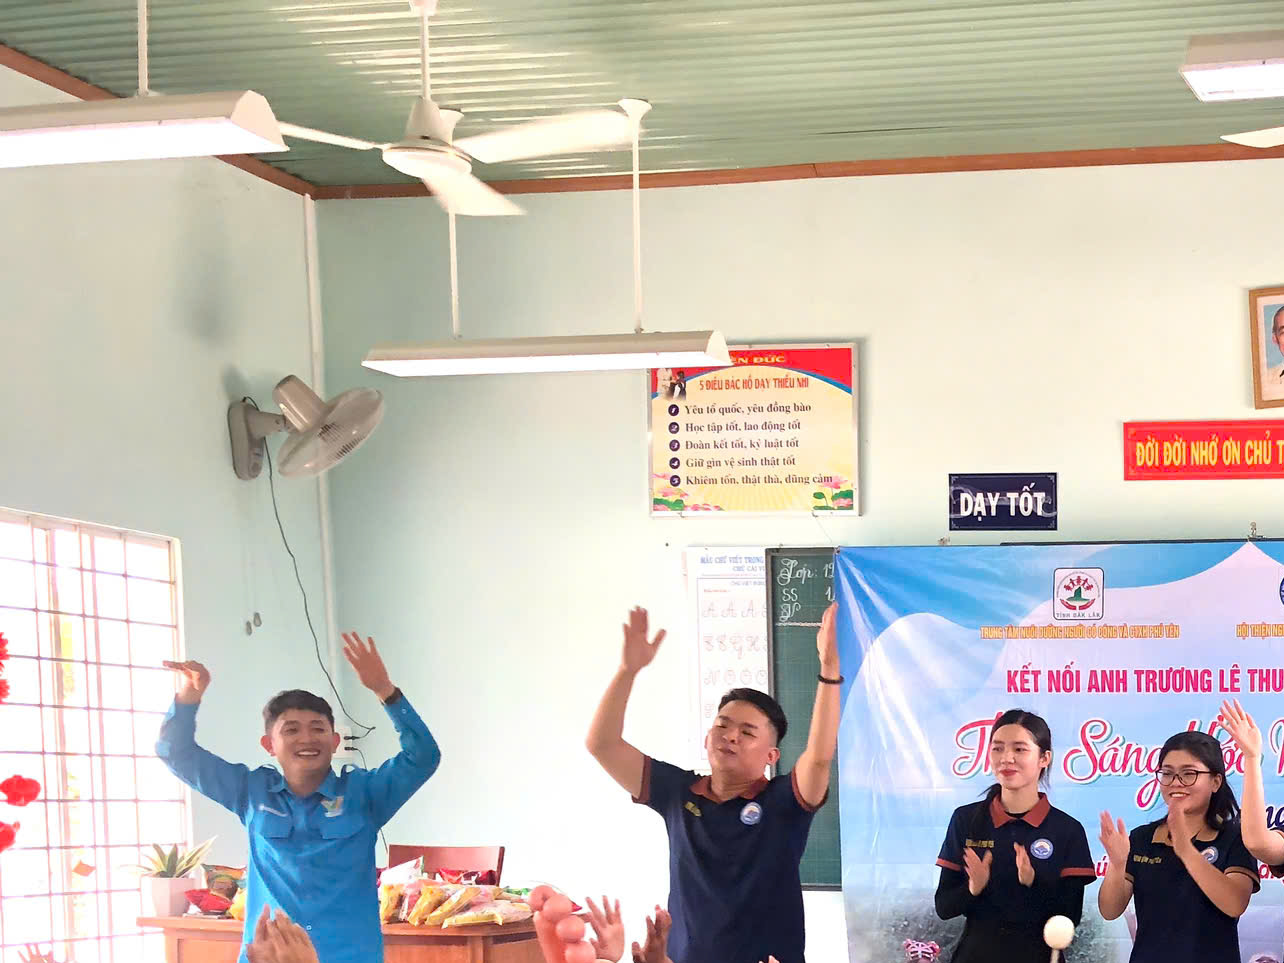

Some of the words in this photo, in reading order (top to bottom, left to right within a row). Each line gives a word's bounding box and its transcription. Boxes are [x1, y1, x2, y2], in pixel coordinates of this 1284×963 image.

[685, 404, 703, 414] Yêu
[706, 402, 716, 414] tổ
[719, 402, 744, 417] quốc,
[747, 404, 764, 417] yêu
[767, 401, 790, 416] đồng
[794, 402, 811, 412] bào
[686, 423, 704, 433] Học
[707, 422, 722, 433] tập
[725, 420, 741, 432] tốt,
[744, 422, 759, 431] lao
[762, 421, 785, 432] động
[788, 418, 801, 430] tốt
[686, 440, 710, 449] Đoàn
[714, 437, 728, 449] kết
[731, 437, 746, 449] tốt,
[765, 438, 783, 450] luật
[786, 436, 799, 447] tốt
[1136, 434, 1159, 466] ĐỜI
[1164, 434, 1187, 466] ĐỜI
[1191, 432, 1217, 465] NHỚ
[1222, 438, 1240, 465] ƠN
[1245, 430, 1271, 464] CHỦ
[686, 457, 704, 467] Giữ
[707, 457, 721, 469] gìn
[725, 457, 734, 469] vệ
[738, 457, 757, 466] sinh
[761, 457, 780, 467] thật
[783, 454, 795, 465] tốt
[686, 475, 717, 485] Khiêm
[721, 474, 739, 485] tốn,
[742, 474, 761, 486] thật
[765, 475, 782, 485] thà,
[786, 474, 809, 485] dũng
[812, 473, 833, 483] cảm
[960, 492, 1000, 521] DẠY
[1006, 482, 1045, 516] TỐT
[1007, 662, 1041, 693] KẾT
[1047, 661, 1080, 693] NỐI
[1087, 669, 1127, 693] ANH
[1134, 667, 1212, 694] TRƯƠNG
[1219, 664, 1241, 692] LÊ
